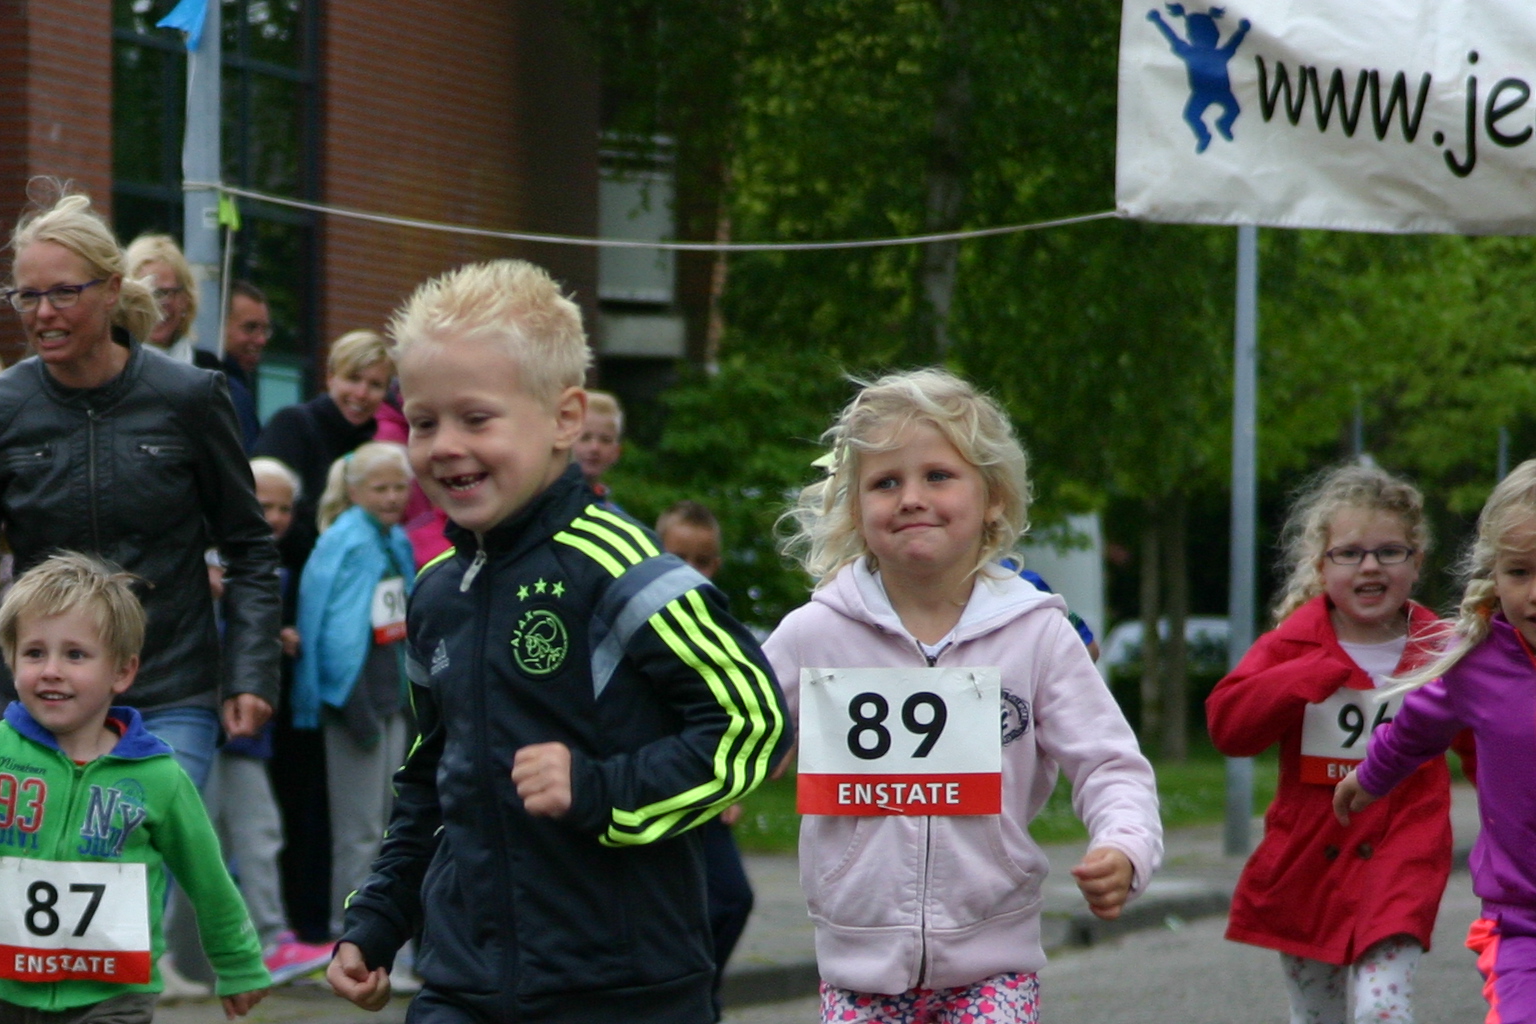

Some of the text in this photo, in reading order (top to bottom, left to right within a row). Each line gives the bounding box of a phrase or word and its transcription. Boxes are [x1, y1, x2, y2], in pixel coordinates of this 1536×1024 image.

[1254, 50, 1534, 178] www.je
[511, 611, 535, 647] AJAX
[847, 691, 948, 760] 89
[1327, 763, 1354, 778] EN
[838, 783, 960, 805] ENSTATE
[80, 784, 147, 857] NY
[24, 880, 107, 937] 87
[14, 953, 117, 975] ENSTATE
